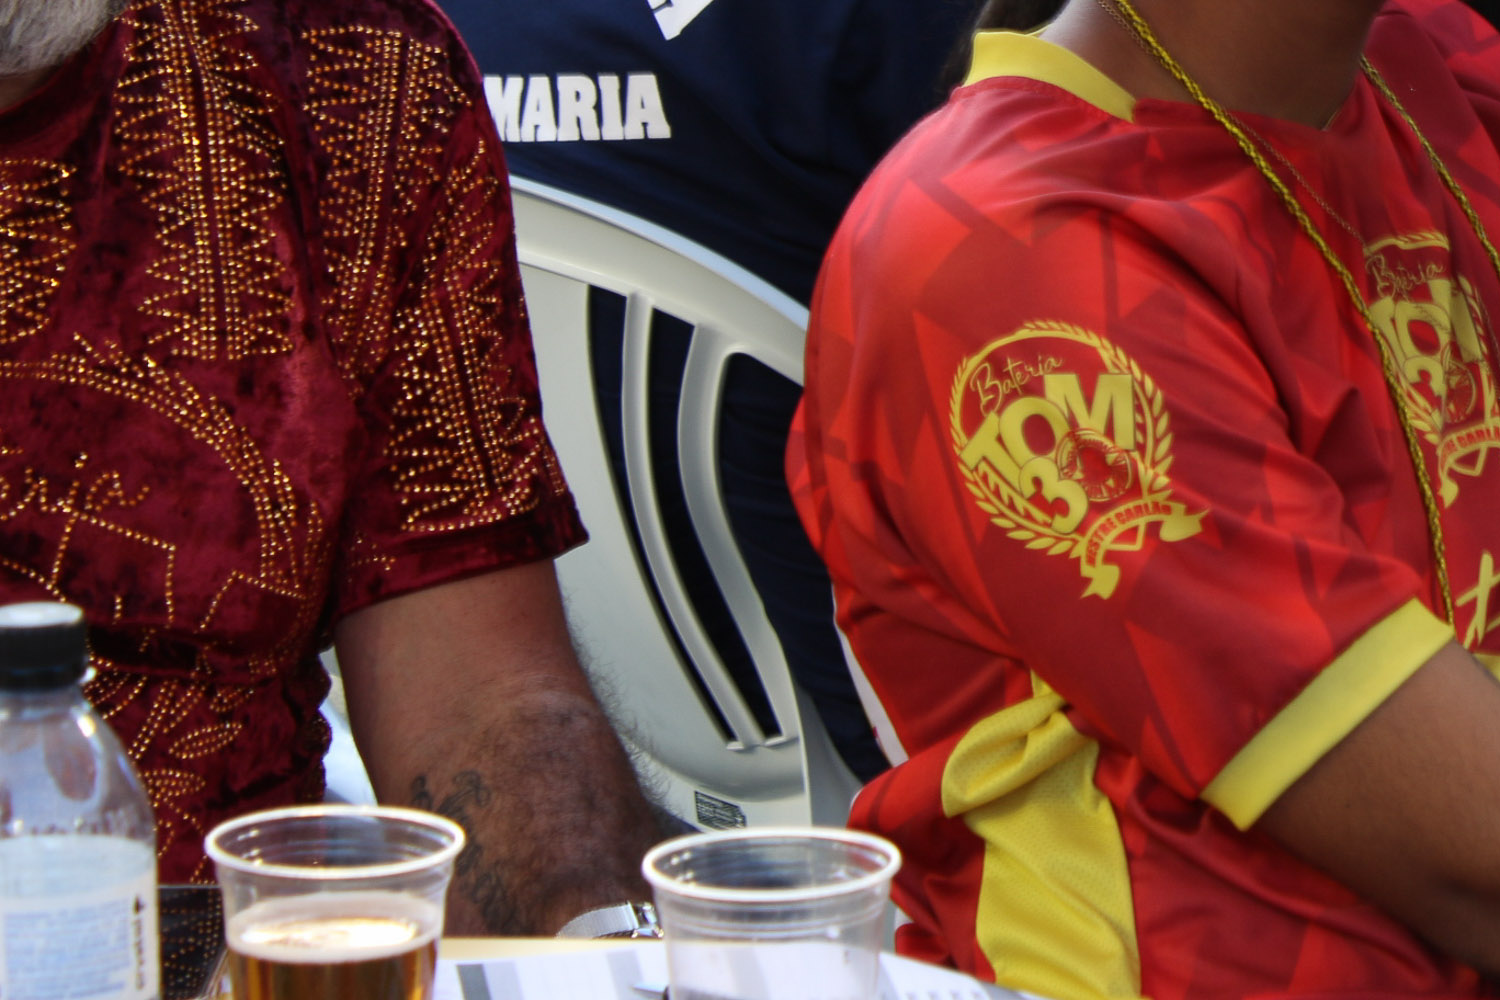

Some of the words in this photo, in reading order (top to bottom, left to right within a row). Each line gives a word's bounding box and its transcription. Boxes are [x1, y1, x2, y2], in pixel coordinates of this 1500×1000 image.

[483, 72, 671, 142] MARIA
[970, 354, 1064, 418] Bateria
[959, 373, 1136, 498] TOM
